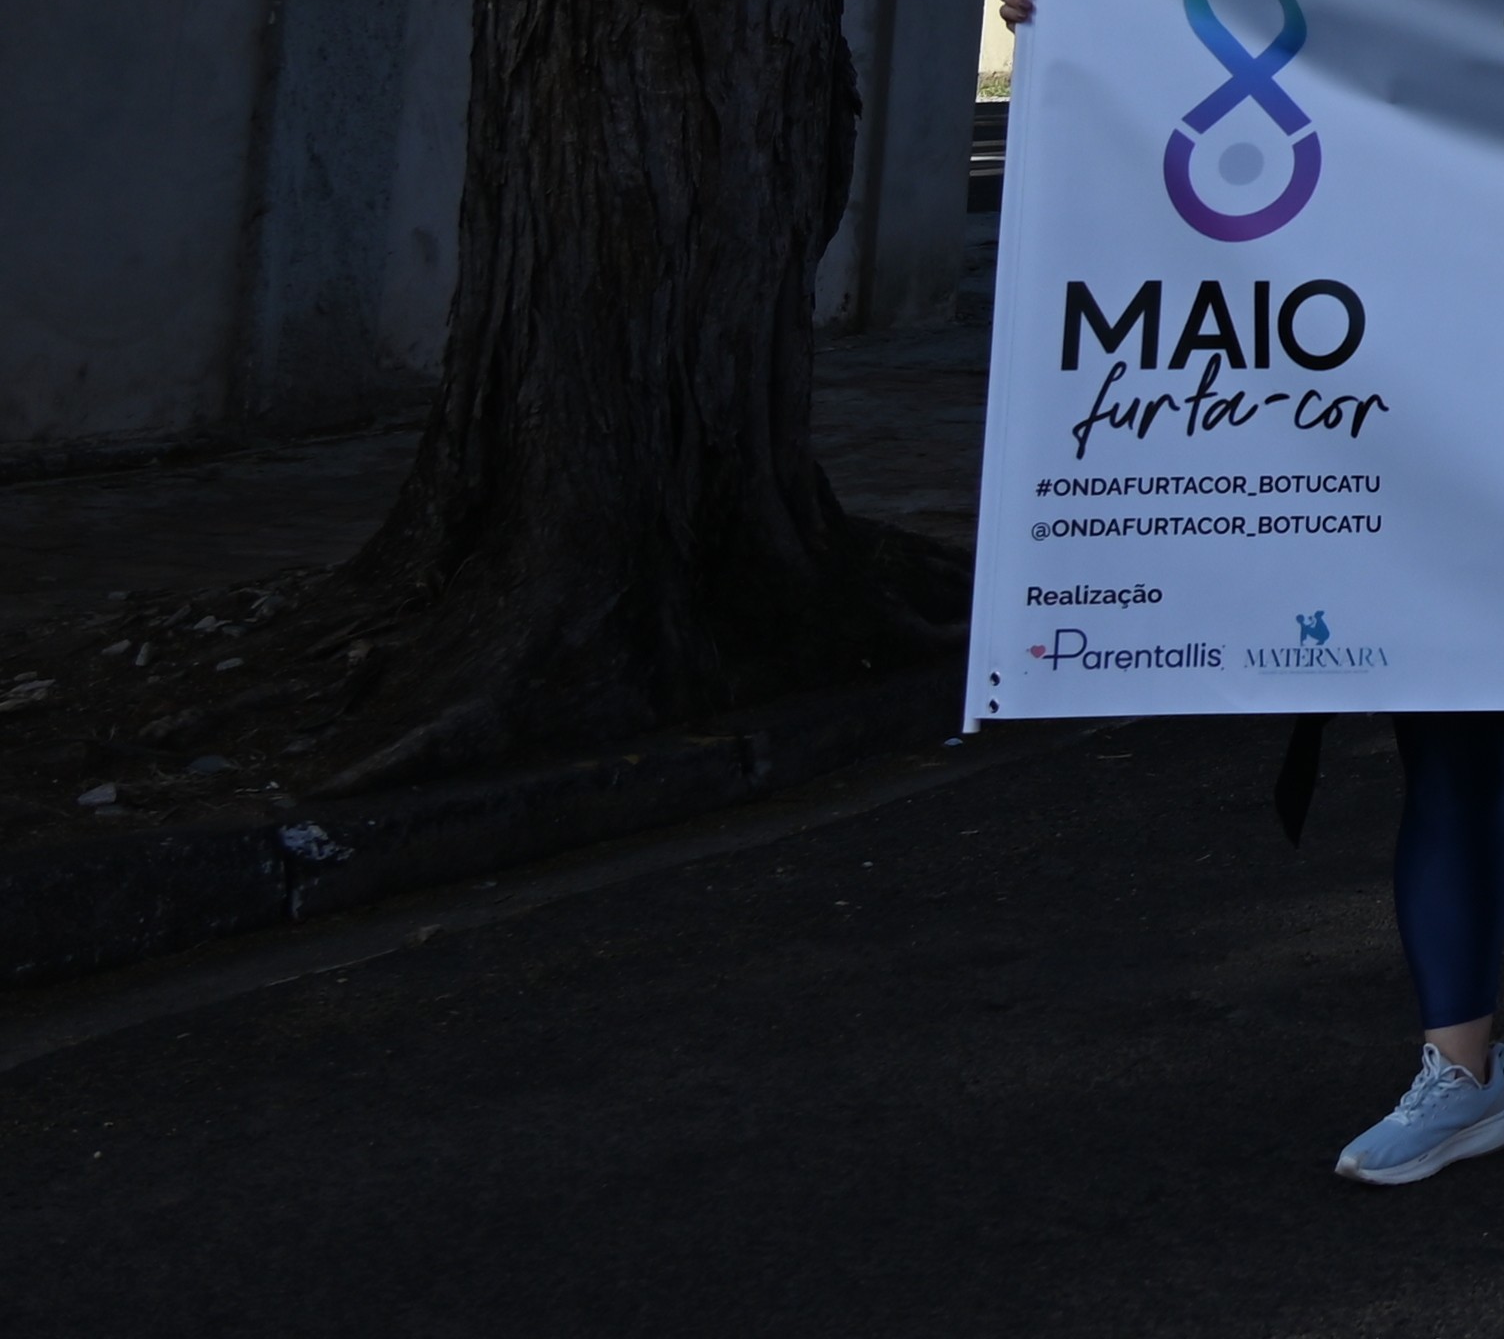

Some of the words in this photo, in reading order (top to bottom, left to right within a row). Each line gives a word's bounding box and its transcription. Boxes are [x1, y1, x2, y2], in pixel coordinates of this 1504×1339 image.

[1060, 279, 1366, 371] MAIO
[1072, 353, 1389, 459] furta-cor
[1036, 475, 1381, 497] #ONDAFURTACOR_BOTUCATU
[1031, 515, 1382, 541] @ONDAFURTACOR_BOTUCATU
[1026, 583, 1163, 609] Realização
[1043, 629, 1222, 671] Parentallis
[1243, 646, 1390, 669] MATERNARA
